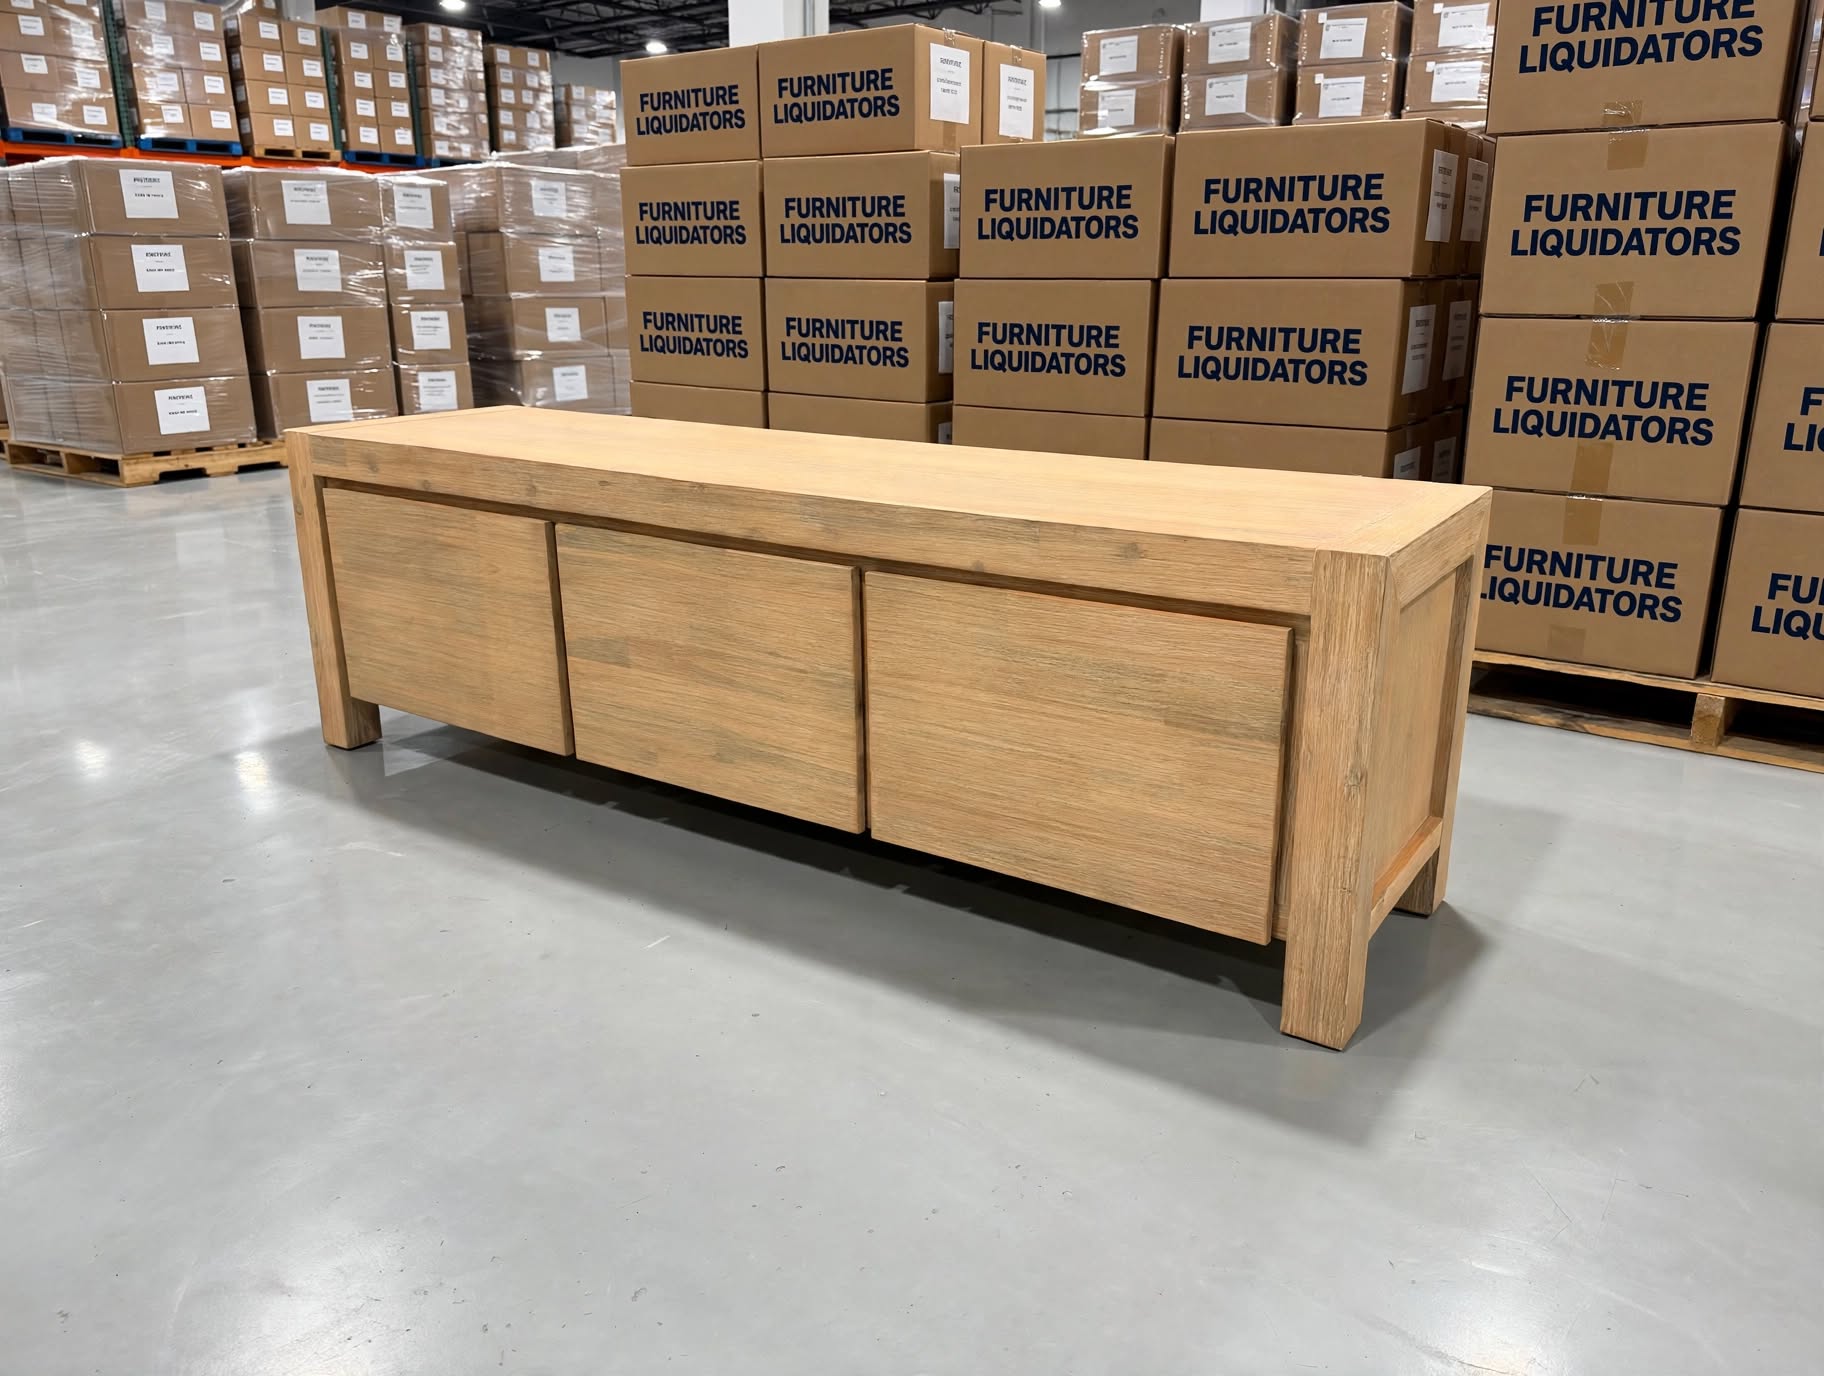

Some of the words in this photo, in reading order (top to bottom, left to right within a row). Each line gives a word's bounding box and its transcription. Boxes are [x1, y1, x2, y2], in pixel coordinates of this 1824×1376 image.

[1533, 0, 1754, 37] FURNITURE
[1519, 25, 1763, 73] LIQUIDATORS
[778, 68, 893, 98] FURNITURE
[640, 85, 739, 112] FURNITURE
[774, 95, 899, 124] LIQUIDATORS
[637, 109, 745, 135] LIQUIDATORS
[985, 185, 1132, 212] FURNITURE
[1204, 173, 1384, 204] FURNITURE
[639, 201, 740, 221] FURNITURE
[785, 195, 905, 218] FURNITURE
[1524, 190, 1736, 222] FURNITURE
[636, 225, 746, 245] LIQUIDATORS
[780, 222, 912, 245] LIQUIDATORS
[978, 215, 1138, 241] LIQUIDATORS
[1194, 207, 1390, 236] LIQUIDATORS
[1511, 226, 1740, 258] LIQUIDATORS
[643, 312, 742, 335] FURNITURE
[786, 317, 902, 342] FURNITURE
[978, 322, 1120, 348] FURNITURE
[640, 334, 748, 358] LIQUIDATORS
[1188, 326, 1361, 354] FURNITURE
[781, 341, 909, 368] LIQUIDATORS
[971, 349, 1125, 377] LIQUIDATORS
[1178, 355, 1368, 386] LIQUIDATORS
[1505, 376, 1709, 411] FURNITURE
[1493, 408, 1713, 446] LIQUIDATORS
[1484, 544, 1678, 589] FURNITURE
[1481, 576, 1682, 622] IQUIDATORS
[1768, 573, 1824, 606] FU
